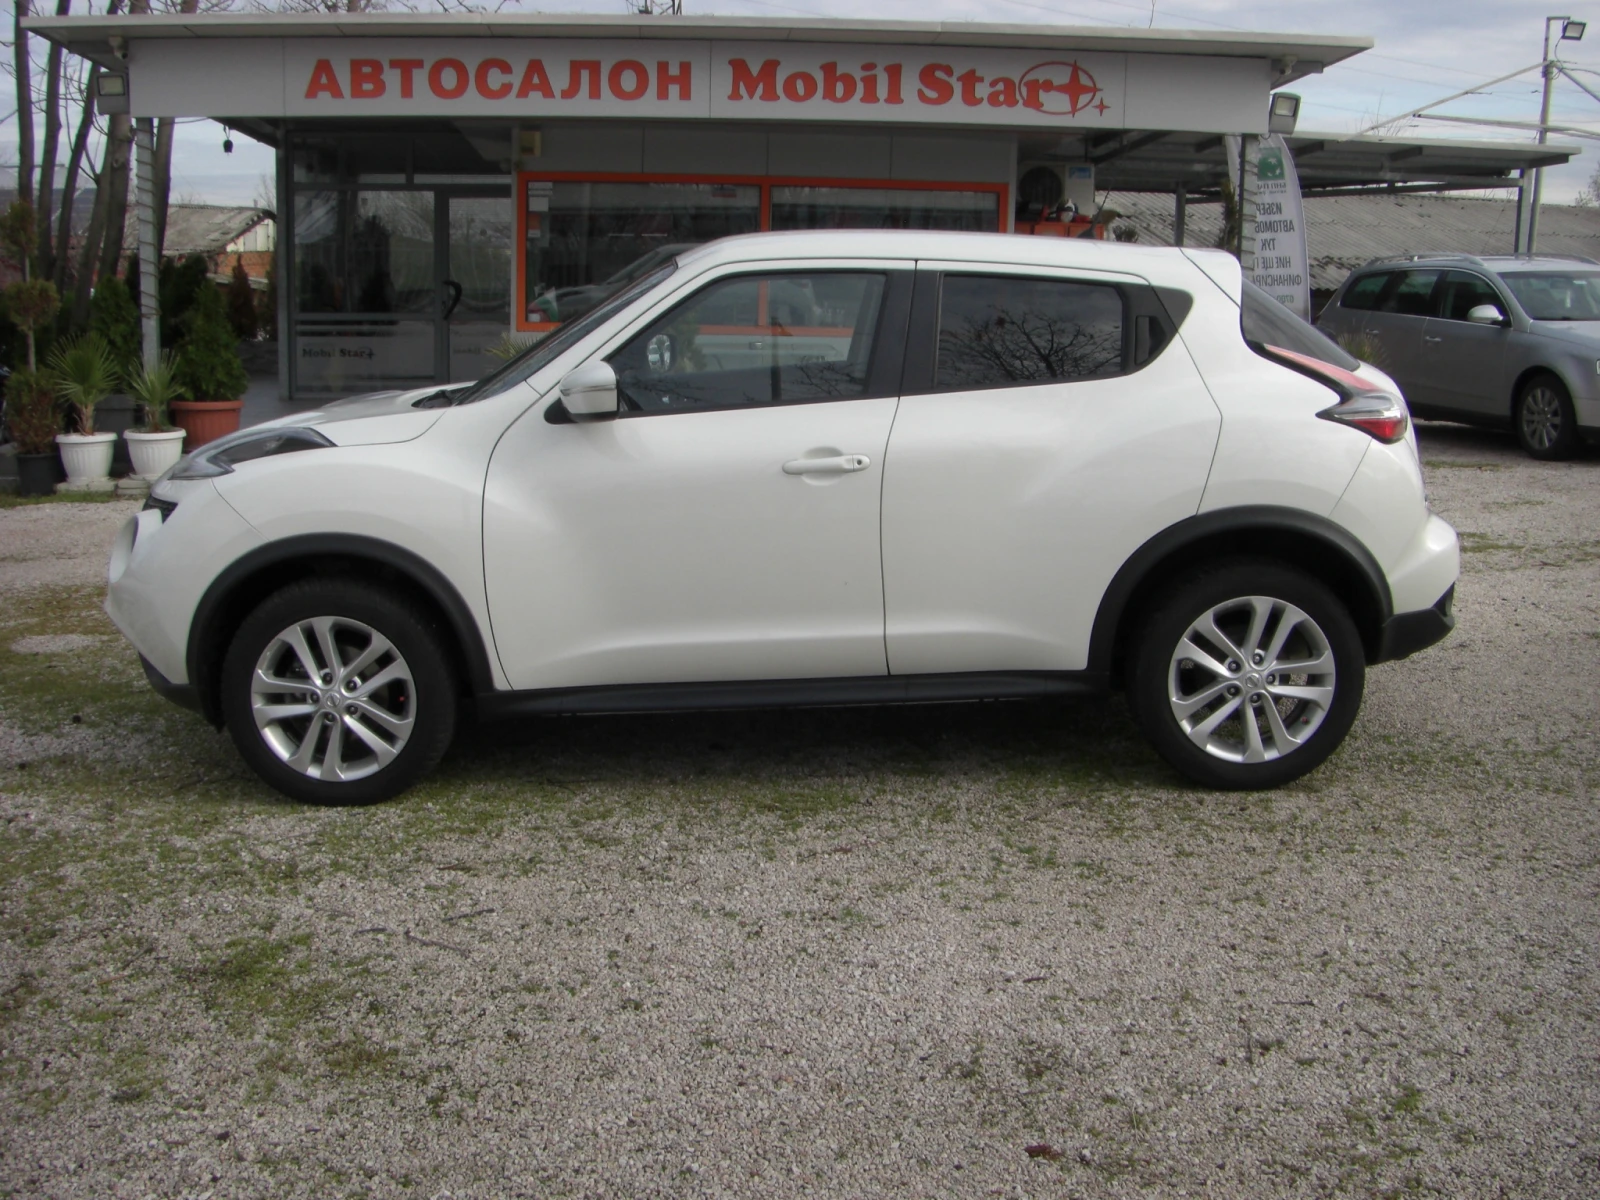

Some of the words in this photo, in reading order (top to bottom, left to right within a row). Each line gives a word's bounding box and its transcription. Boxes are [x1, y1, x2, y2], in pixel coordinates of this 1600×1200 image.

[304, 57, 692, 101] АВТОСАЛОН
[727, 58, 905, 104] Mobil
[917, 62, 1054, 110] Star
[302, 347, 336, 358] Mobil
[339, 347, 366, 358] Star
